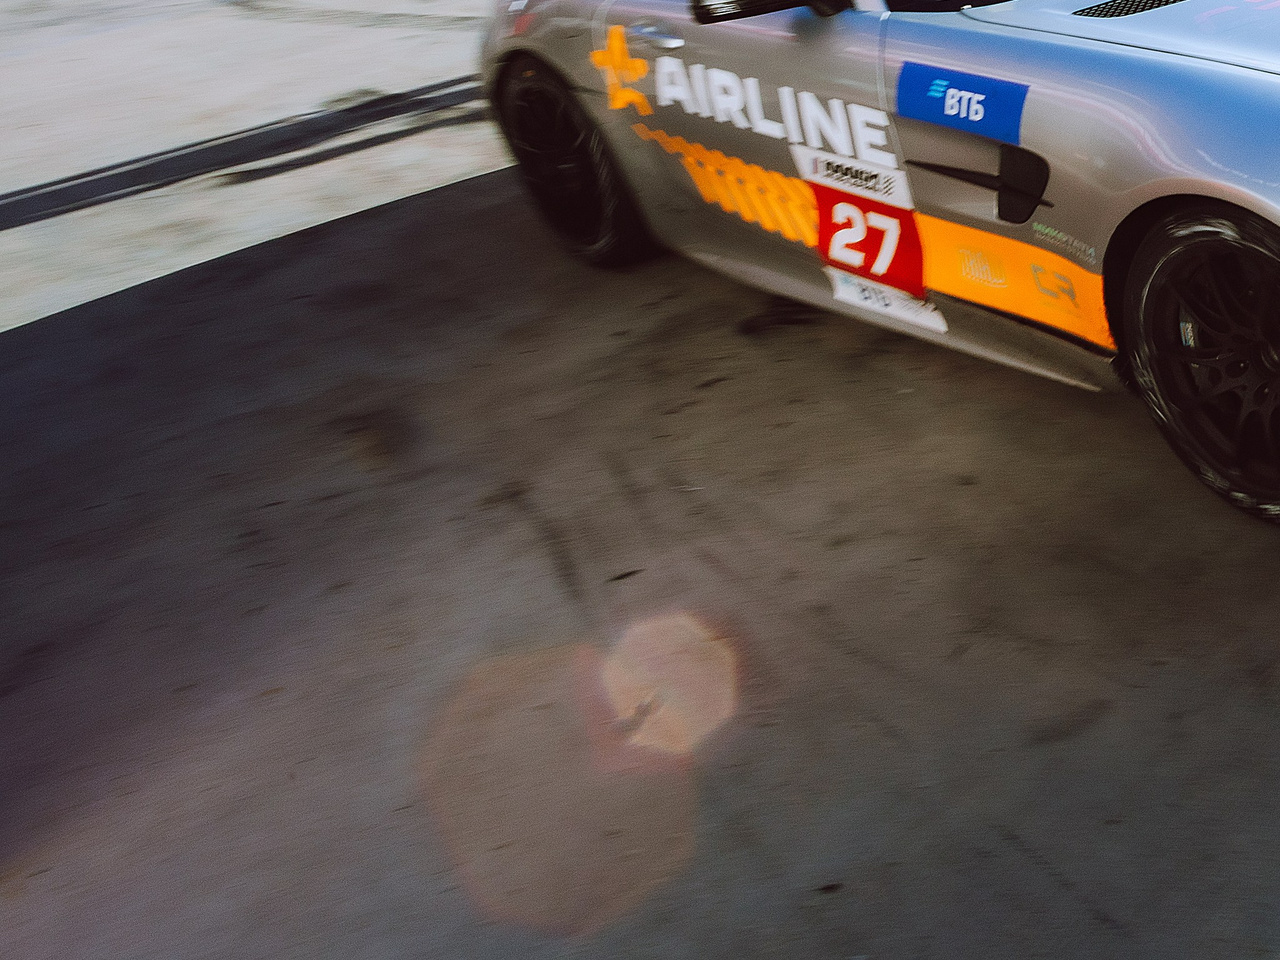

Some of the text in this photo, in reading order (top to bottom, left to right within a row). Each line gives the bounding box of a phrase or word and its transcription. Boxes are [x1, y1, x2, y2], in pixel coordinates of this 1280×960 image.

[655, 56, 897, 168] AIRLINE
[944, 87, 985, 122] ВТБ
[828, 202, 902, 276] 27
